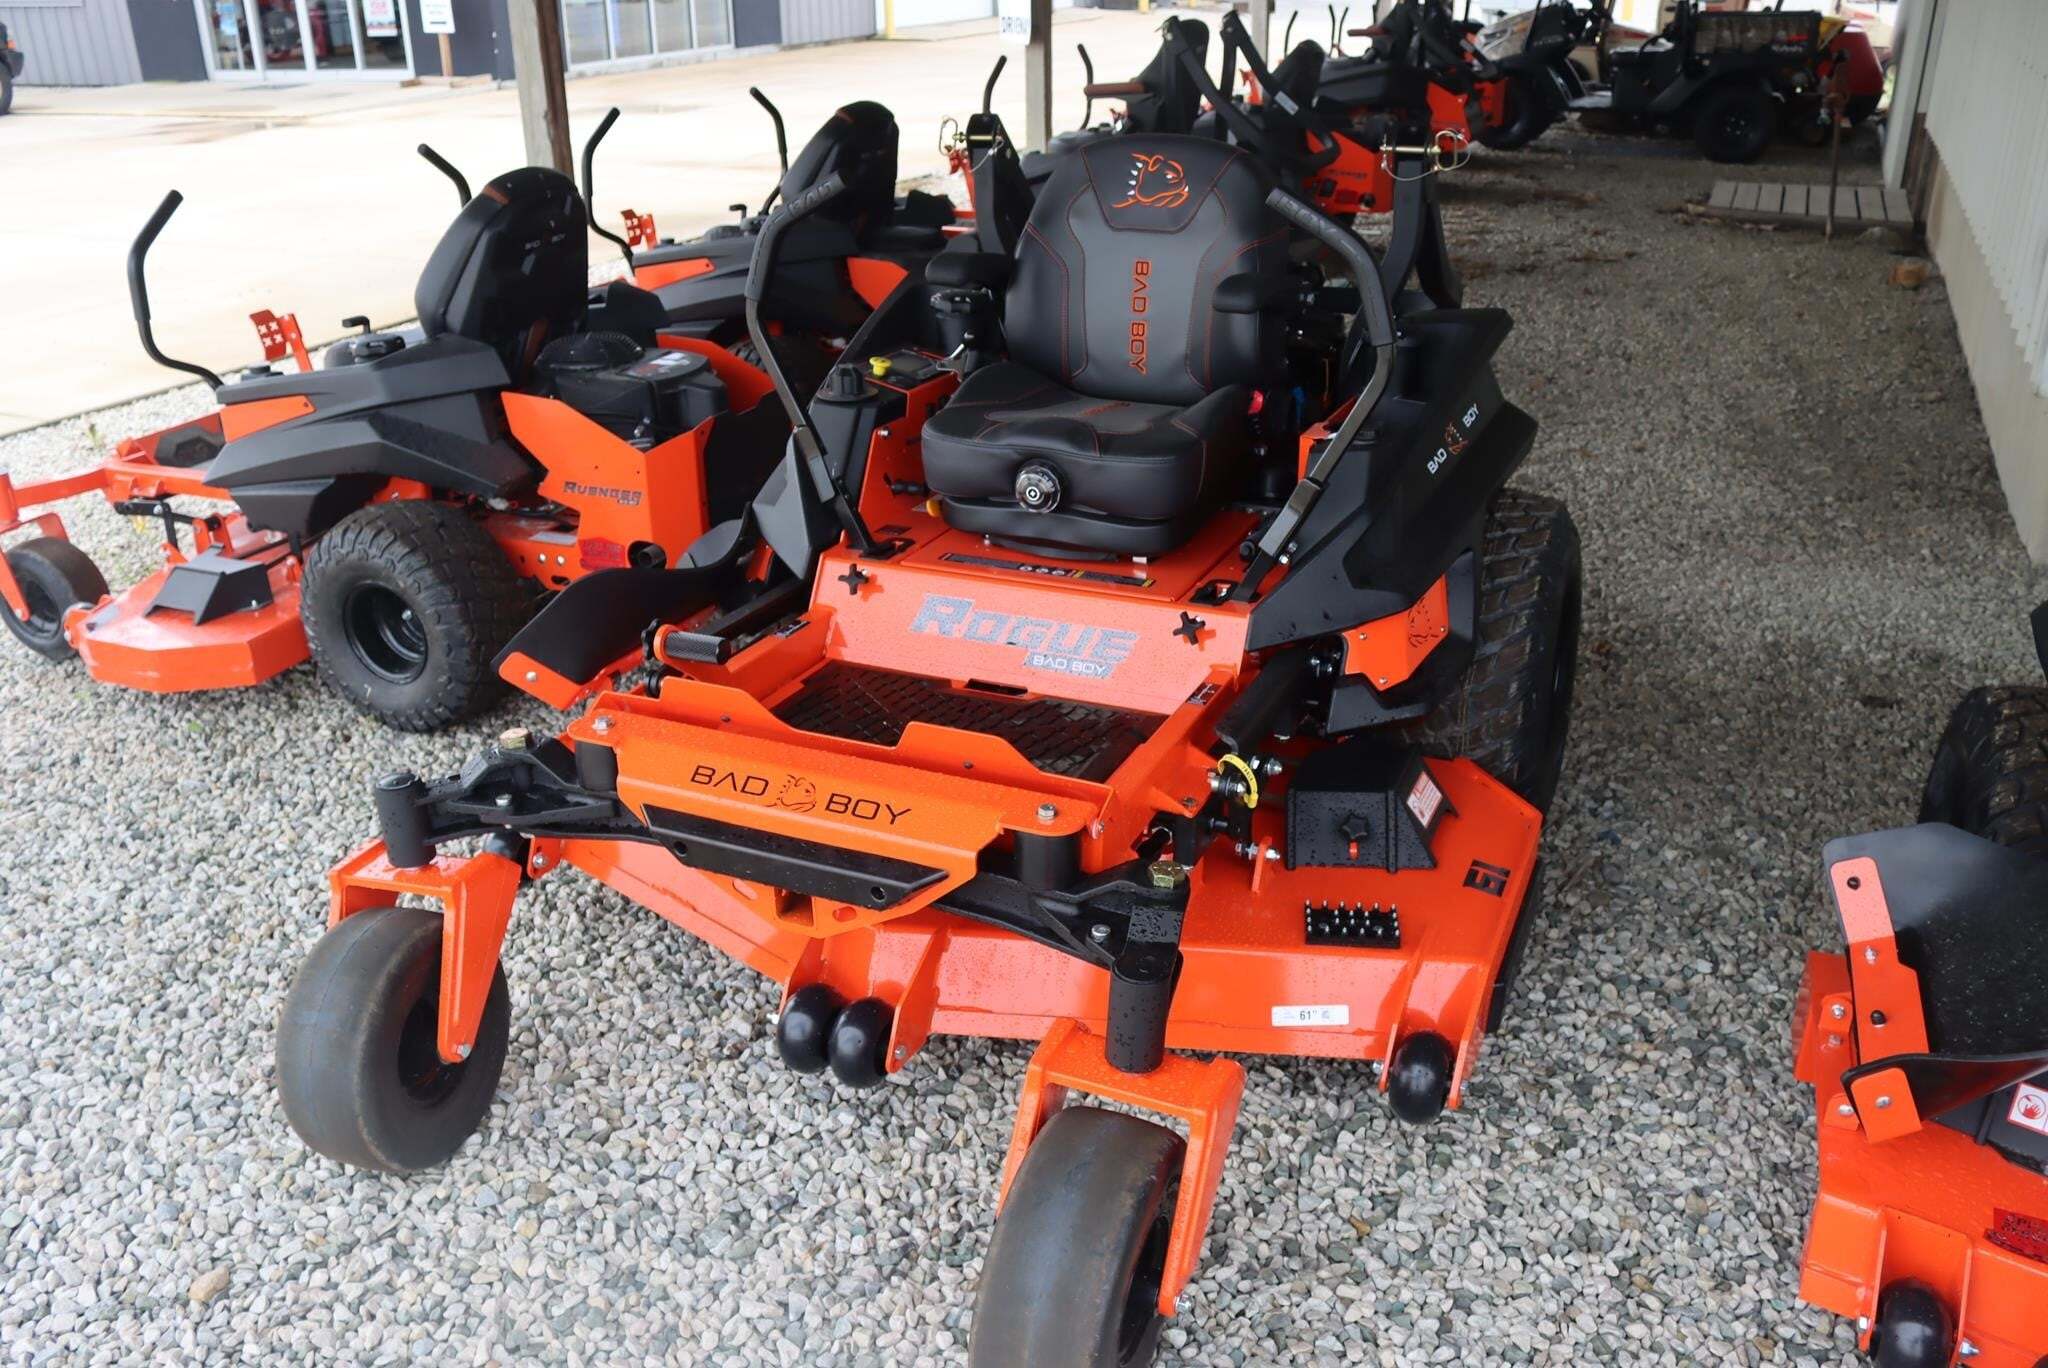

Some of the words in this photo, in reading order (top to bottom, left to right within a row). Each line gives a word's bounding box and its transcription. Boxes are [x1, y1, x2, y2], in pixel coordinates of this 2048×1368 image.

[1132, 260, 1149, 313] BAD
[1129, 321, 1146, 374] BOY
[1427, 448, 1447, 474] BAD
[1462, 403, 1479, 428] BOY
[1032, 654, 1068, 669] BAD
[1071, 660, 1108, 676] BOY
[690, 764, 769, 796] BAD
[825, 792, 912, 825] BOY
